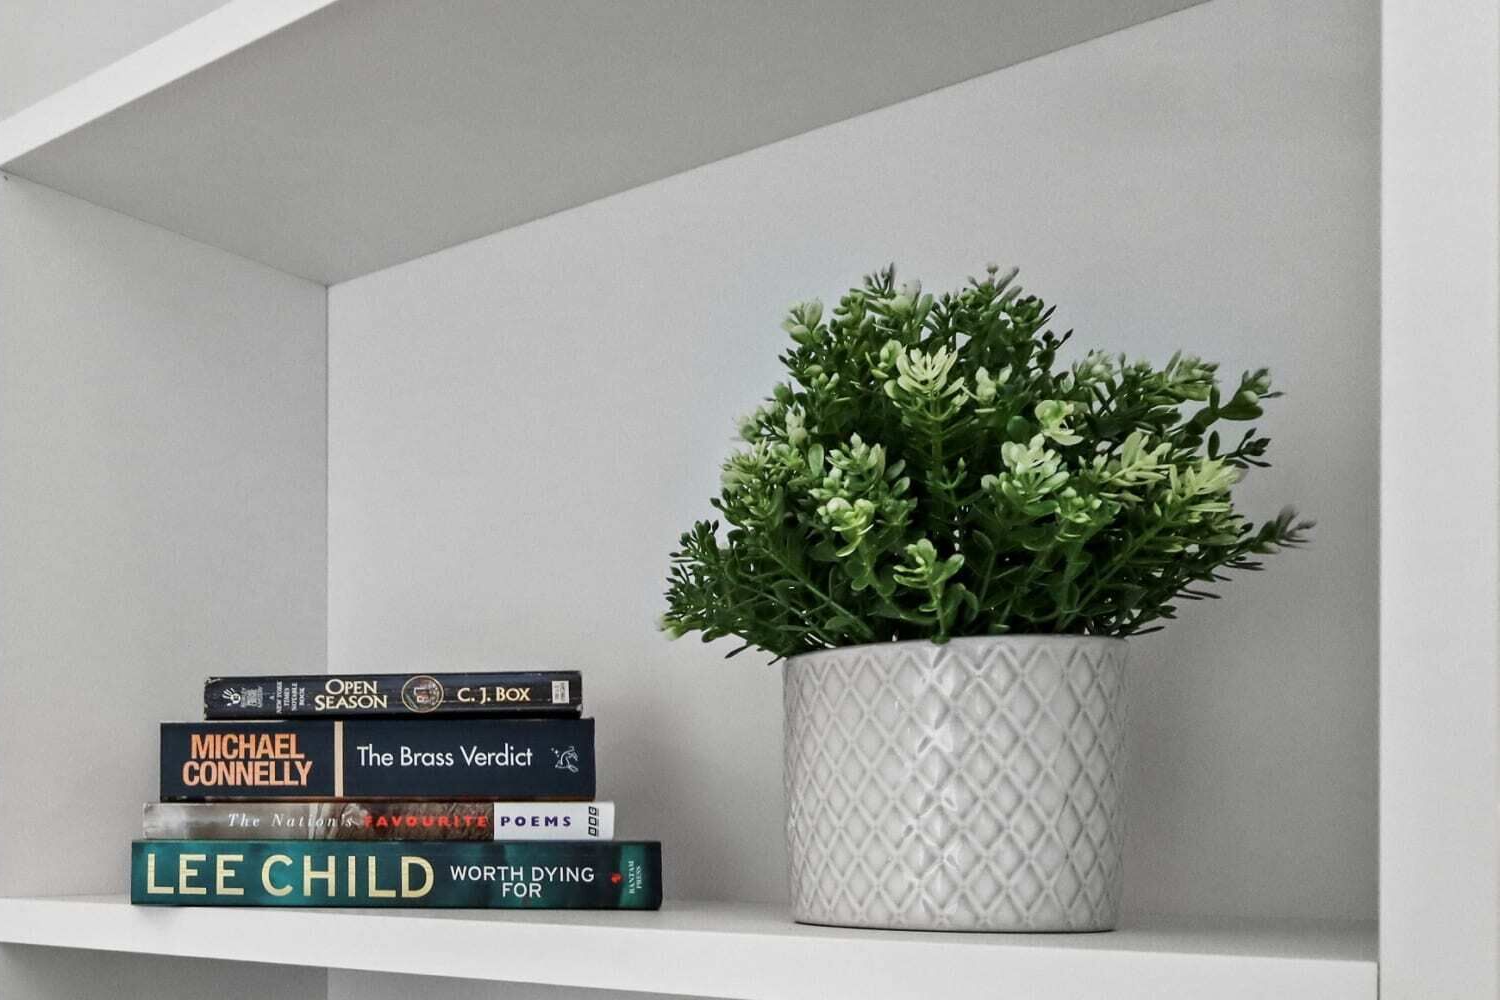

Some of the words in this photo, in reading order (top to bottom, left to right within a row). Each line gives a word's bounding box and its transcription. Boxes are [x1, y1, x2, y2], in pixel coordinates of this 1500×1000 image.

[325, 679, 378, 695] OPEN
[457, 687, 475, 702] C.
[479, 687, 491, 704] J.
[496, 687, 531, 701] BOX
[314, 695, 388, 711] SEASON
[191, 734, 305, 759] MICHAEL
[357, 744, 393, 766] The
[400, 746, 454, 766] Brass
[460, 743, 532, 766] Verdict
[182, 760, 313, 786] CONNELLY
[228, 813, 260, 827] The
[271, 813, 353, 828] Nation's
[363, 815, 487, 828] FAVOURITE
[500, 816, 572, 827] POEMS
[147, 853, 245, 895] LEE
[261, 854, 435, 898] CHILD
[450, 865, 524, 882] WORTH
[531, 866, 595, 883] DYING
[502, 882, 542, 898] FOR
